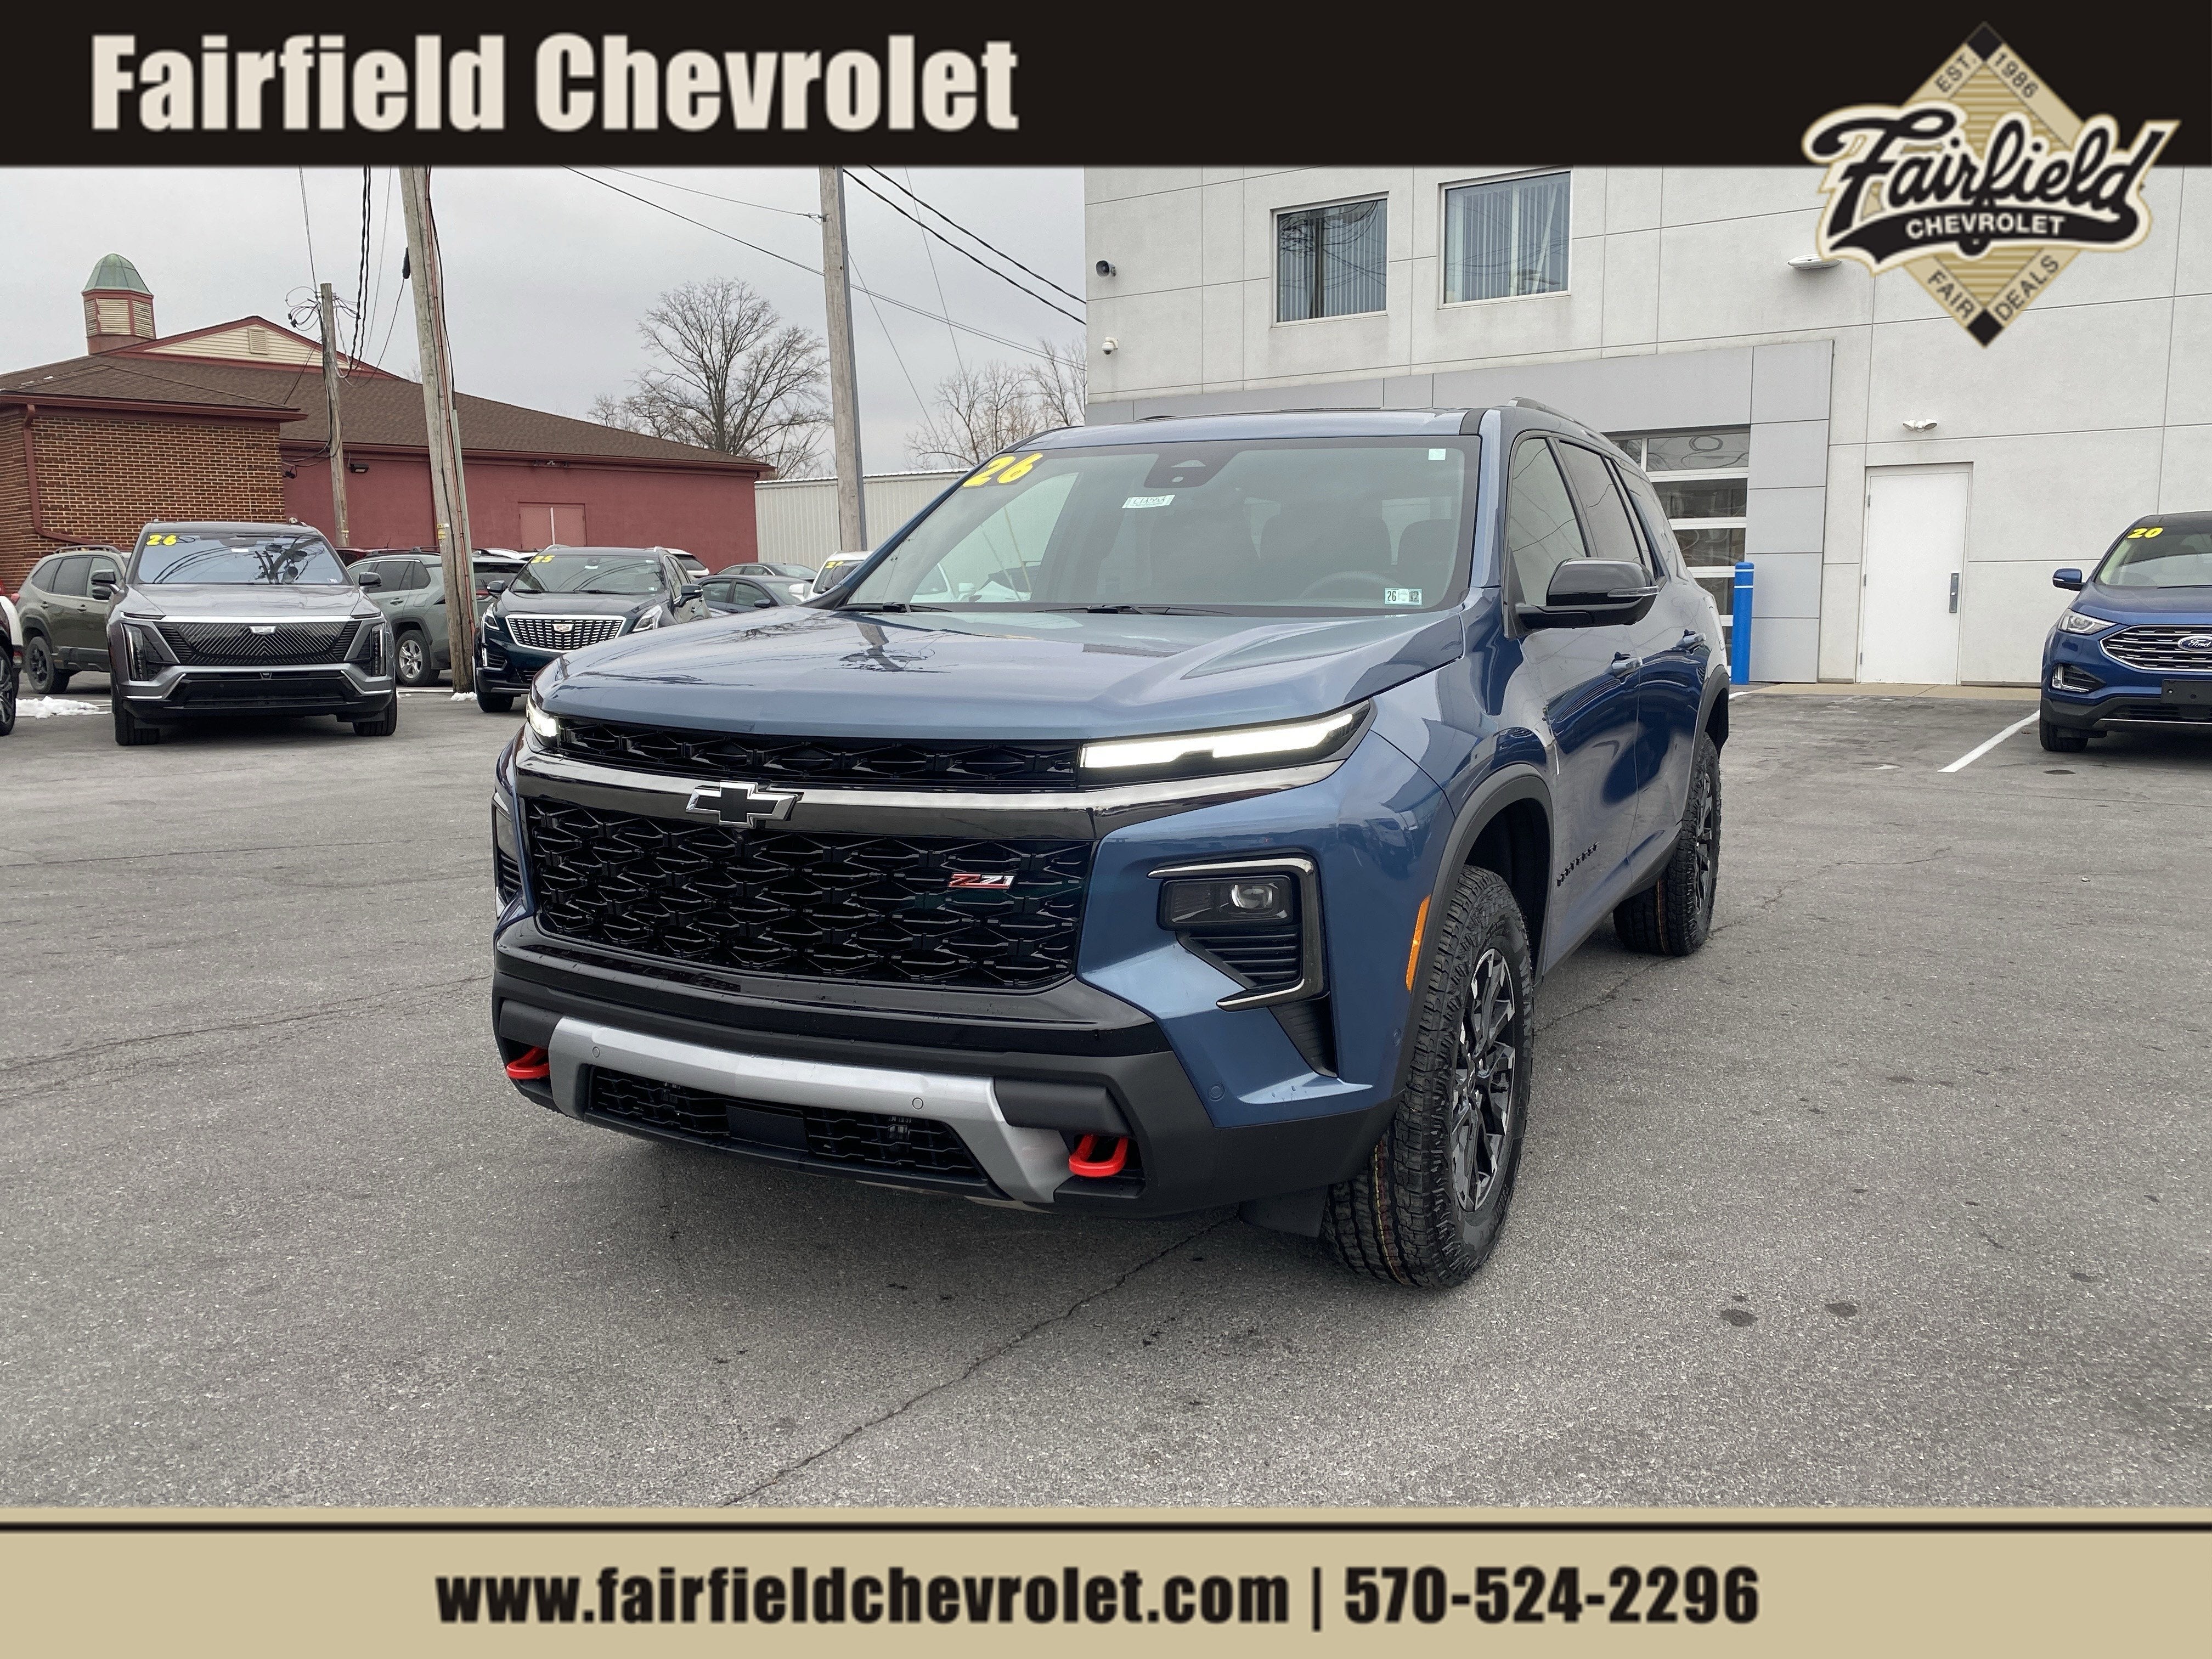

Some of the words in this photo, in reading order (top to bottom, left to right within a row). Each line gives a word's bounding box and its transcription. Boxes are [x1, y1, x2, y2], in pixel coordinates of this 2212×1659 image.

[962, 453, 1043, 488] 26
[2127, 527, 2163, 539] 20
[146, 534, 177, 546] 26
[531, 555, 555, 563] 25
[1387, 590, 1396, 601] 26
[2188, 639, 2211, 648] Ford
[948, 873, 1015, 889] Z71
